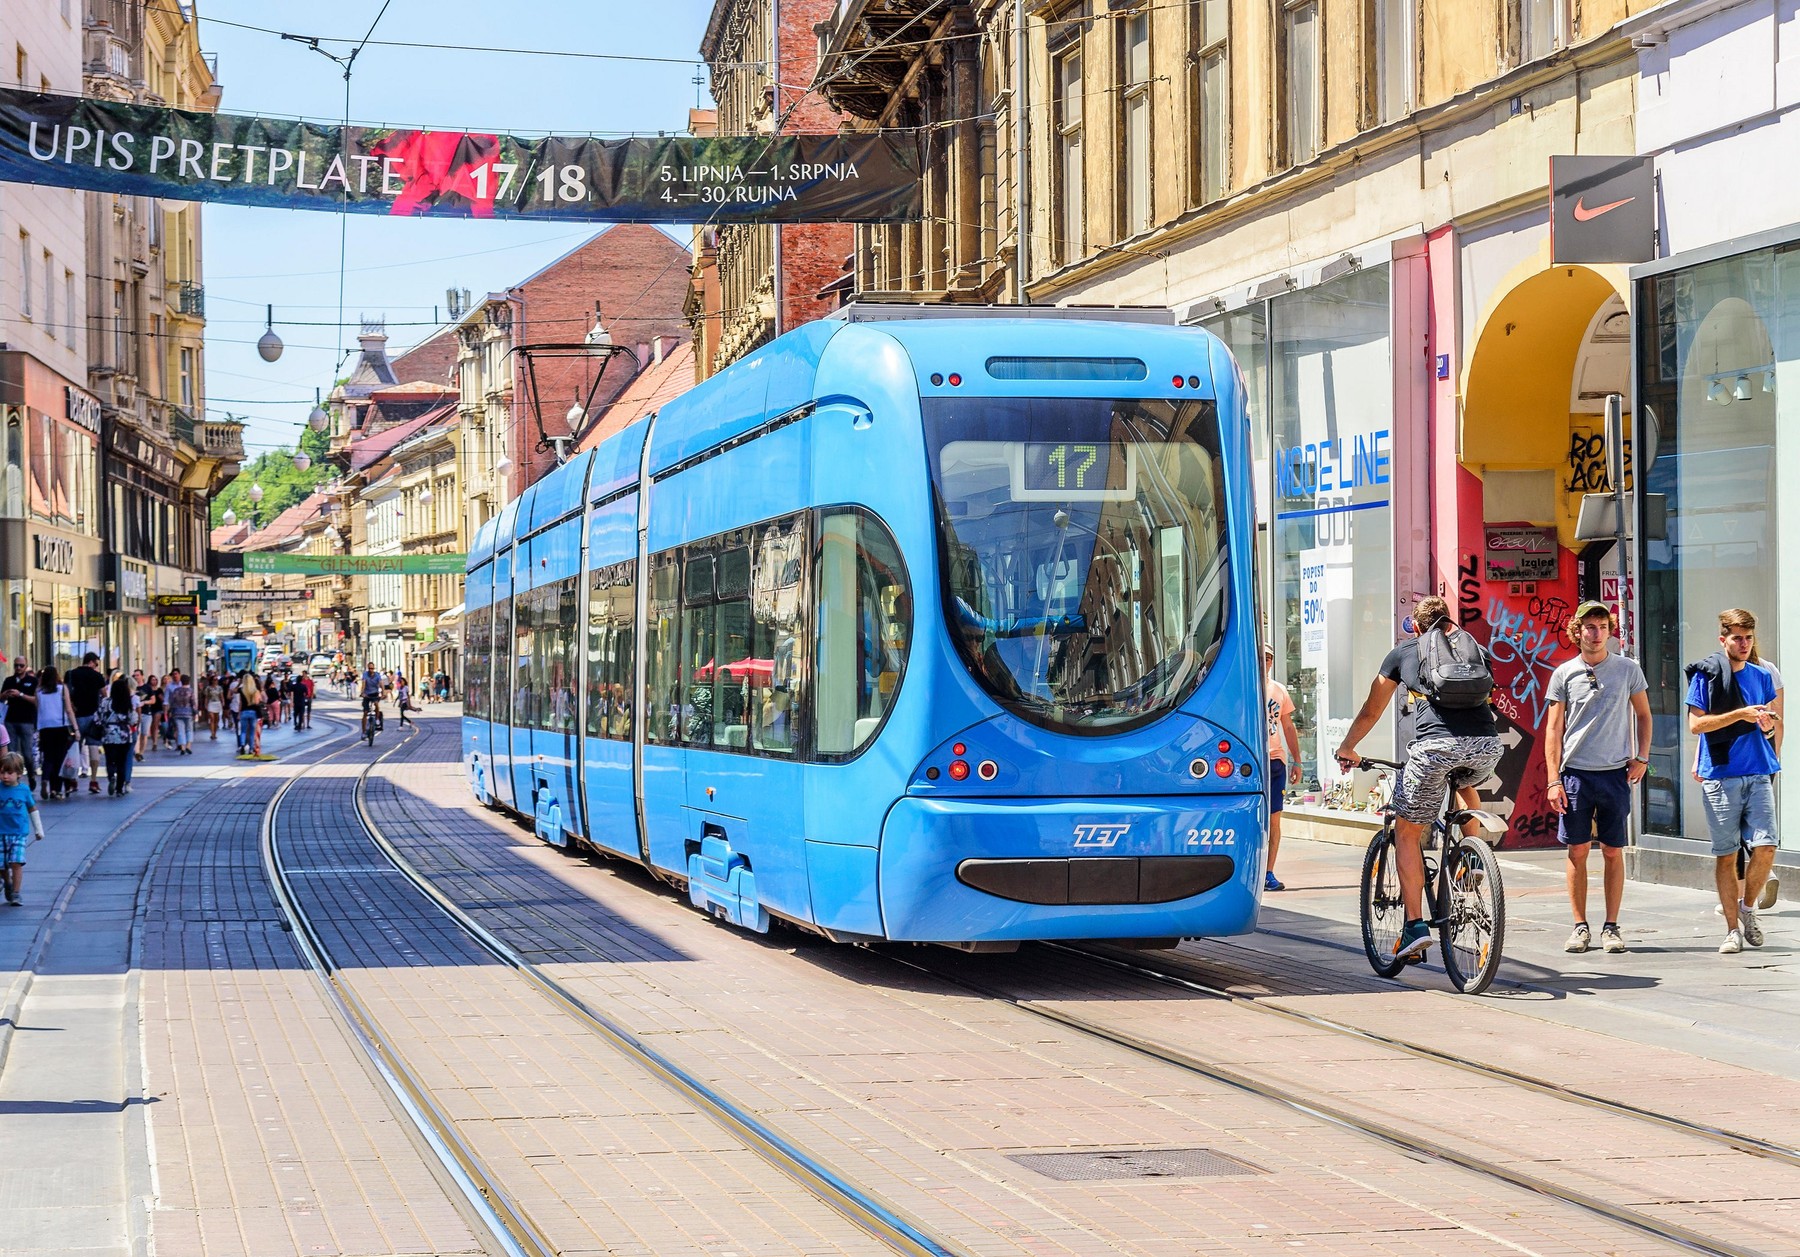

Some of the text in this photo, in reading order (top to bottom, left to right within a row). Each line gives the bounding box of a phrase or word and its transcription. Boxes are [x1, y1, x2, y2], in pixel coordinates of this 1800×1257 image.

[28, 121, 134, 171] UPIS
[150, 135, 404, 195] PRETPLATE
[660, 165, 677, 182] 5.
[788, 162, 859, 183] SRPNJA
[736, 185, 798, 205] RUJNA
[1048, 444, 1097, 488] 17
[1277, 429, 1389, 498] MODE LINE
[320, 558, 404, 572] GLEMBAJEVI
[1302, 564, 1324, 580] POPUST
[1521, 558, 1555, 569] Izgled
[1309, 581, 1318, 594] DO
[1304, 596, 1325, 625] 50%
[1072, 823, 1131, 848] ZET
[1187, 828, 1235, 845] 2222
